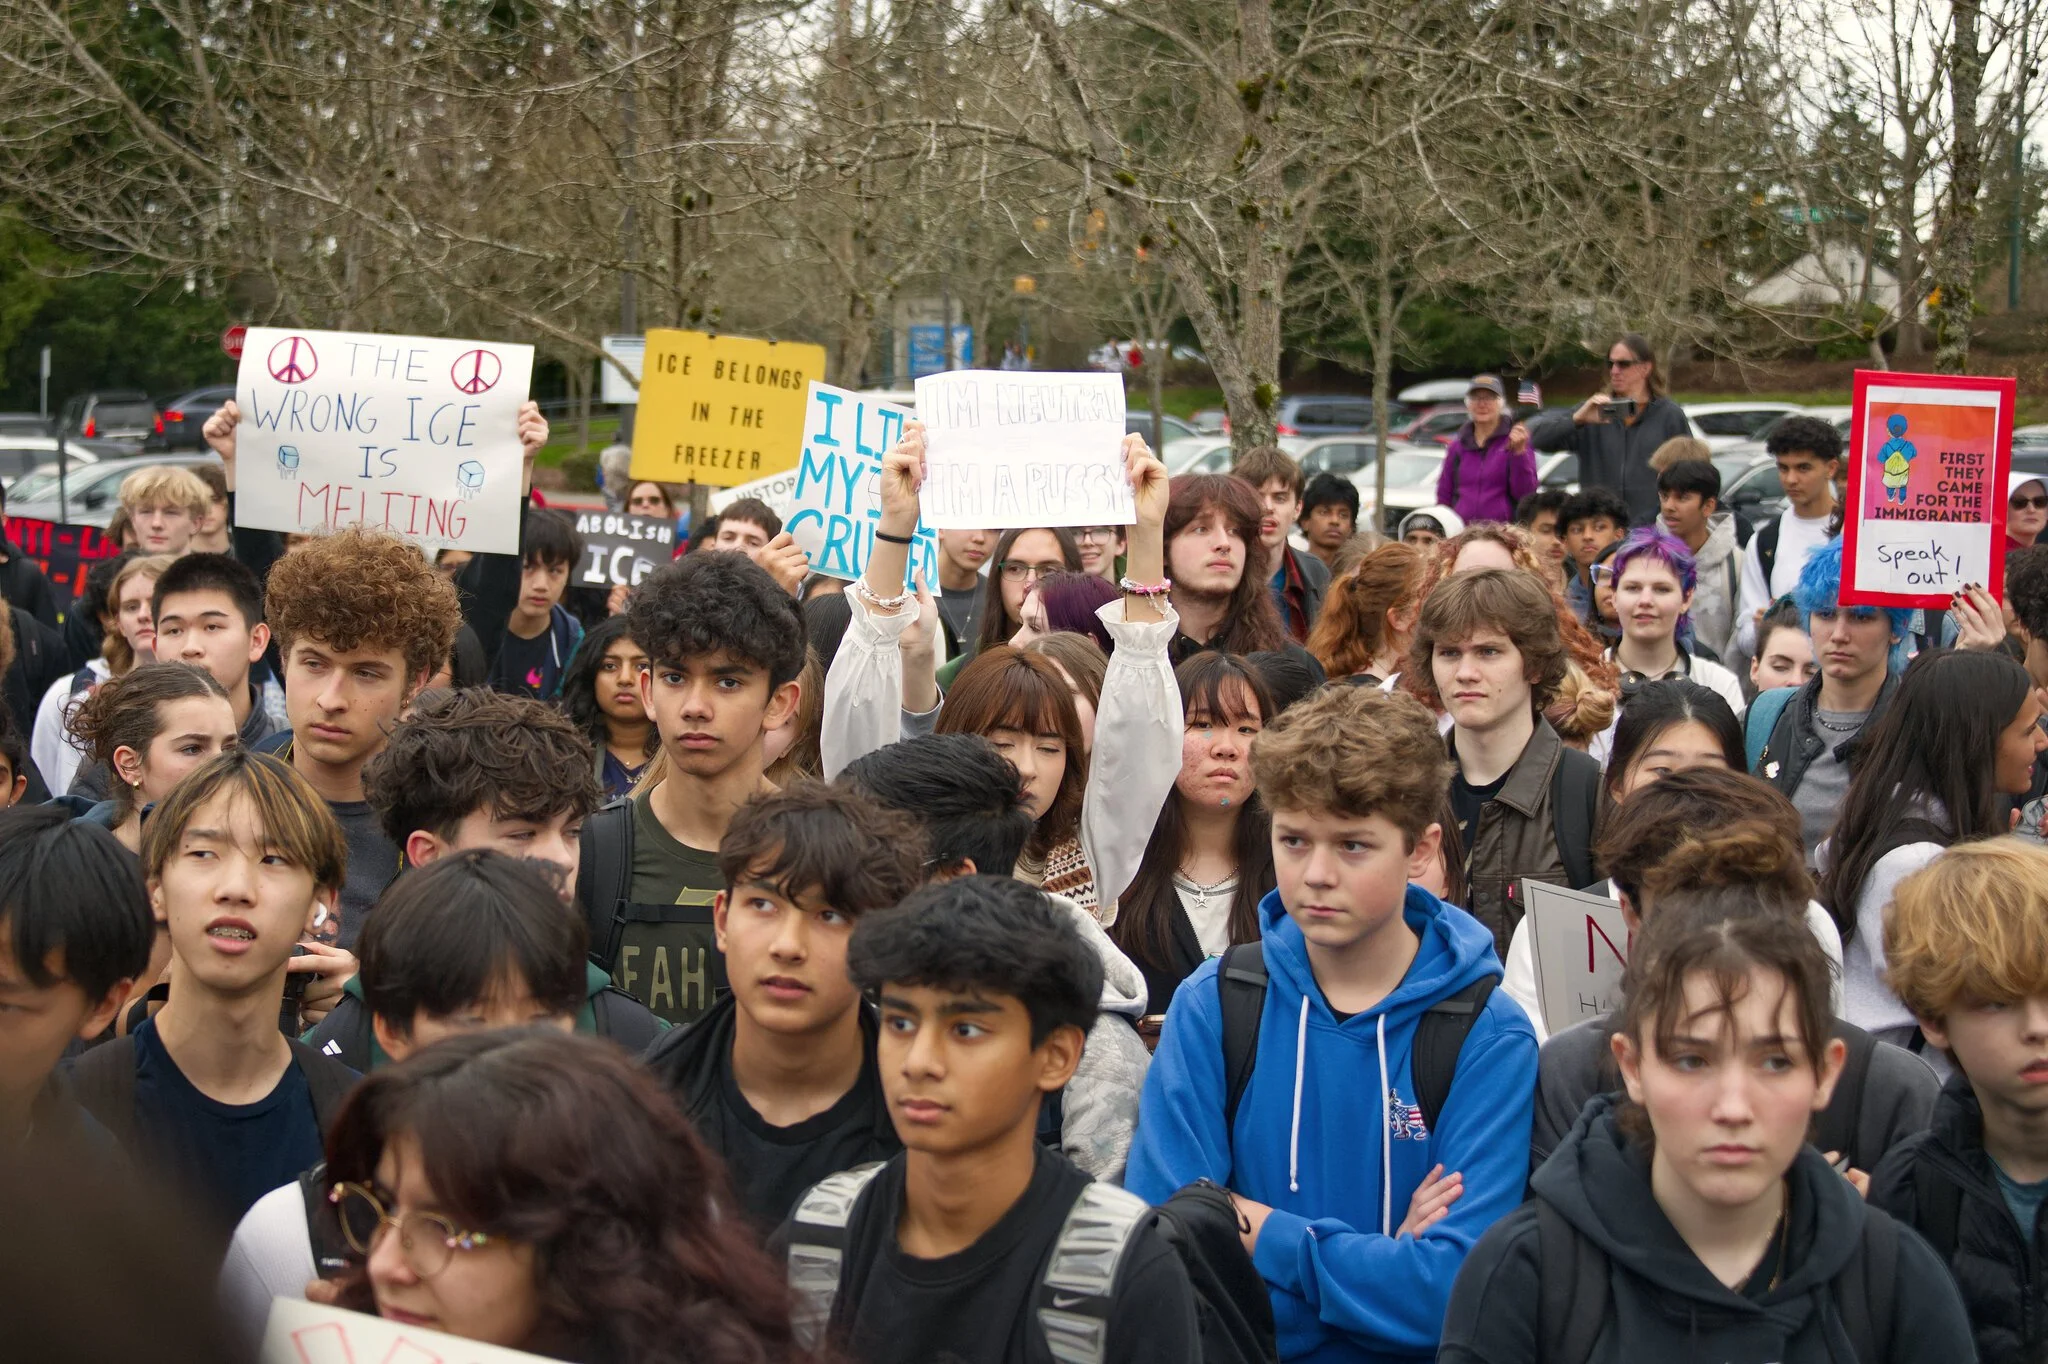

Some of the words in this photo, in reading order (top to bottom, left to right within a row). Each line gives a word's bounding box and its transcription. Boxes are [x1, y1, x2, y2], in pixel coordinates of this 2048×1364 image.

[345, 341, 430, 383] THE
[657, 352, 692, 377] ICE
[713, 359, 803, 391] BELONGS
[251, 387, 378, 434] WRONG
[402, 396, 481, 447] ICE
[690, 401, 711, 423] IN
[729, 405, 764, 429] THE
[813, 391, 843, 447] I
[995, 382, 1125, 426] NEUTRAL
[357, 445, 398, 479] IS
[673, 444, 761, 471] FREEZER
[1940, 452, 1985, 466] FIRST
[1945, 466, 1985, 480] THEY
[795, 447, 865, 515] MY
[992, 464, 1021, 516] A
[1025, 462, 1127, 516] PUSSY
[1937, 480, 1983, 494] CAME
[1875, 506, 1982, 523] IMMIGRANTS
[1916, 494, 1948, 507] FOR
[1953, 495, 1982, 508] THE
[576, 513, 672, 544] ABOLISH
[786, 508, 938, 591] CRUED
[1877, 539, 1950, 570] Speak
